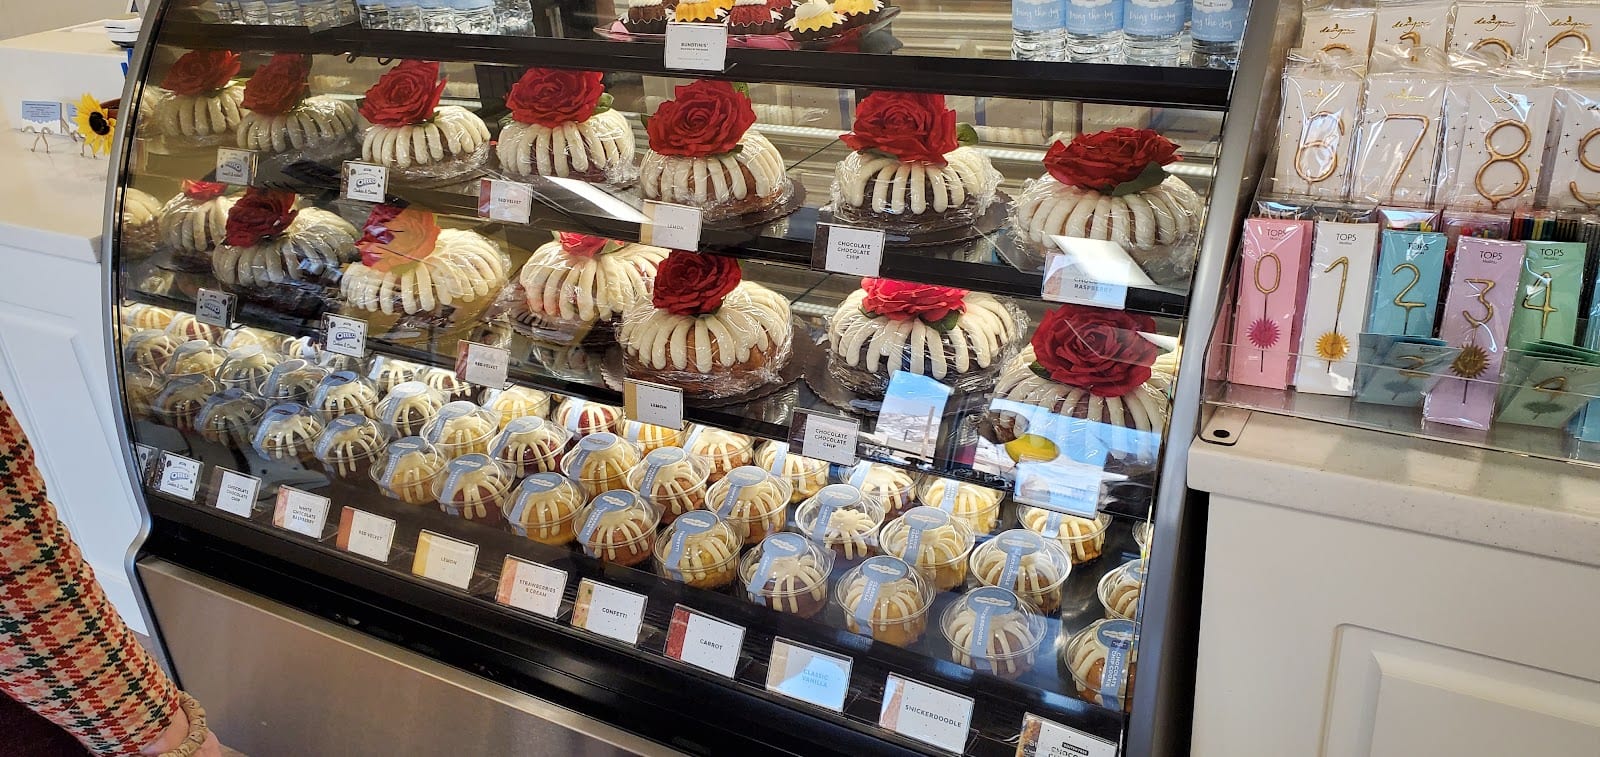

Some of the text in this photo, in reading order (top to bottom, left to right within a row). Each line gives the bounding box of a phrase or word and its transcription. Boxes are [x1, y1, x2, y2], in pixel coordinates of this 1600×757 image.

[1295, 111, 1345, 184] 6
[1385, 113, 1430, 193] 7
[1475, 119, 1531, 203] 8
[1336, 233, 1357, 241] TOPS
[837, 246, 870, 256] CHOCOLATE
[838, 240, 871, 250] CHOCOLATE
[1479, 250, 1503, 261] TOPS
[1539, 249, 1565, 257] TOPS
[1254, 252, 1281, 294] 0
[1323, 256, 1349, 316] 1
[1392, 263, 1427, 308] 2
[1463, 278, 1496, 328] 3
[1522, 271, 1559, 335] 4
[814, 434, 847, 446] CHOCOLATE
[815, 428, 849, 440] CHOCOLATE
[226, 489, 248, 500] CHOCOLATE
[228, 484, 249, 495] CHOCOLATE
[440, 557, 458, 566] LEMON
[530, 588, 548, 598] CREAM
[602, 607, 629, 619] CONFETTI
[699, 638, 724, 651] CARROT
[804, 669, 829, 680] CLASSIC
[1110, 652, 1122, 688] CHOCOLATE
[801, 675, 829, 689] VANILLA
[904, 703, 963, 729] SNICKERDOODLE
